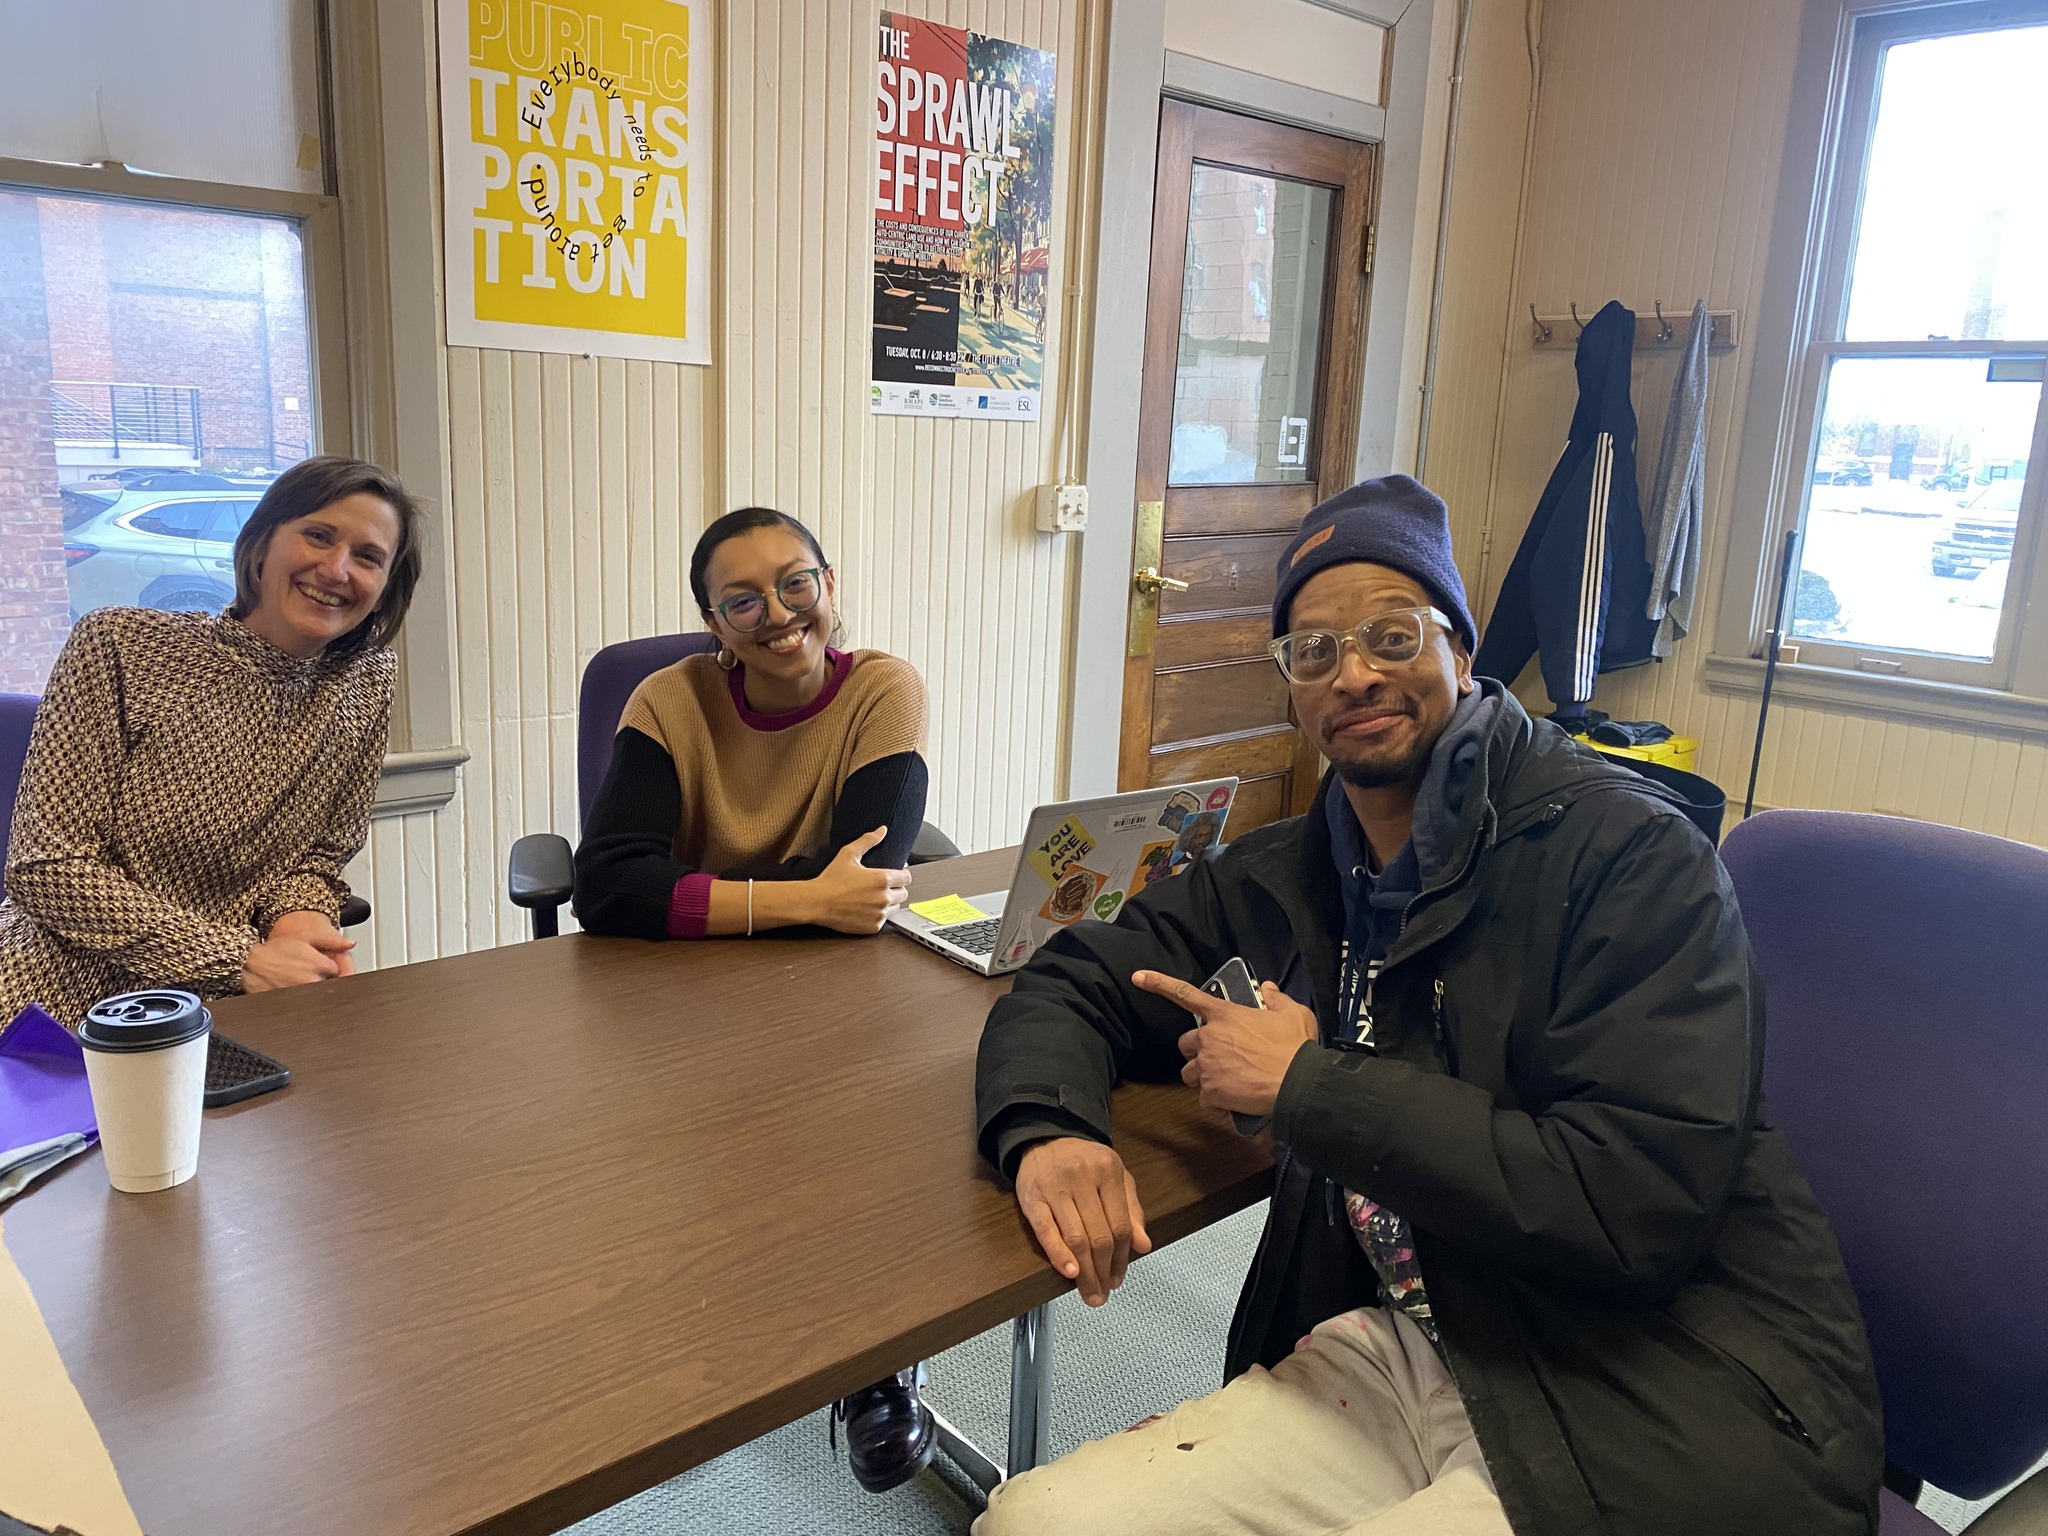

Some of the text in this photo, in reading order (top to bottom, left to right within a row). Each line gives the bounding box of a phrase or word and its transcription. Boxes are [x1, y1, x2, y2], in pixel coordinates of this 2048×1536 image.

[468, 0, 689, 101] PUBLIC
[879, 25, 910, 61] THE
[521, 51, 622, 131] Everybody
[876, 60, 1021, 159] SPRAWL
[468, 65, 689, 170] TRANS
[624, 113, 656, 162] needs
[471, 140, 689, 238] PORTA
[633, 172, 653, 198] to
[875, 138, 1005, 227] EFFECT
[591, 213, 628, 264] get
[876, 219, 885, 227] THE
[885, 220, 899, 228] COSTS
[899, 222, 908, 230] AND
[906, 233, 917, 241] LAND
[916, 234, 926, 242] USE
[926, 236, 934, 244] AND
[934, 237, 944, 245] HOW
[473, 215, 646, 299] TION
[886, 346, 909, 360] TUESDAY,
[910, 348, 922, 359] OCT.
[972, 354, 982, 363] THE
[982, 355, 998, 365] LITTLE
[998, 356, 1018, 366] THEATRE
[1017, 400, 1032, 412] ESL
[1038, 822, 1072, 853] YOU
[1050, 834, 1081, 868] ARE
[1052, 841, 1092, 881] LOVE
